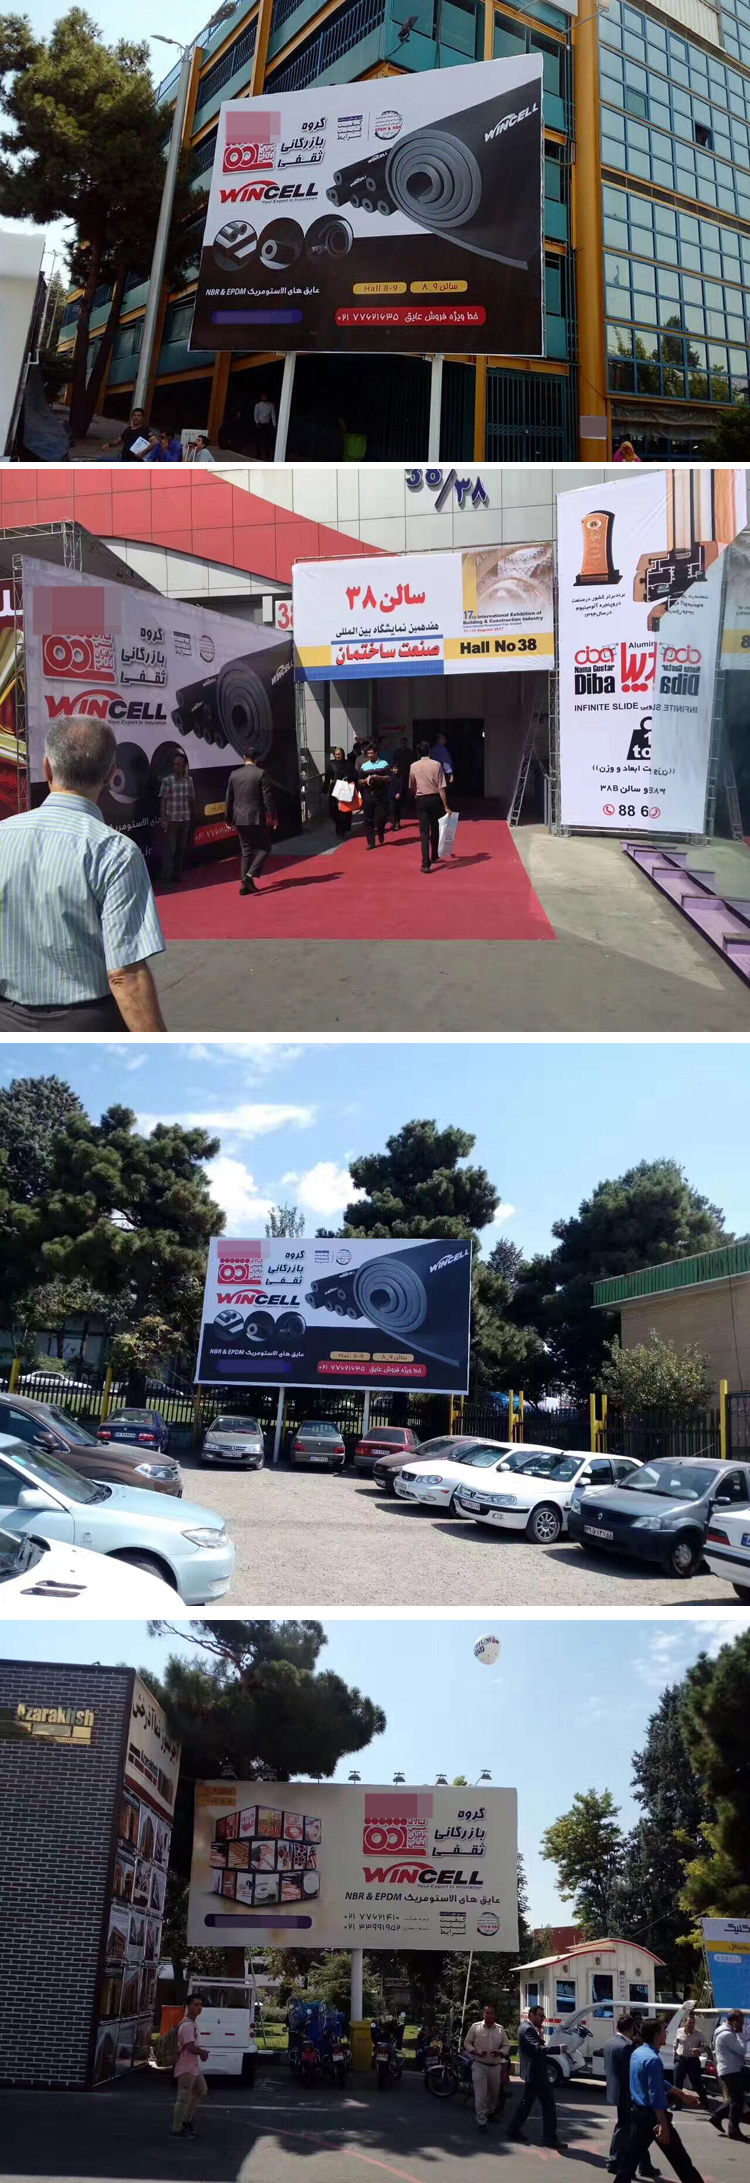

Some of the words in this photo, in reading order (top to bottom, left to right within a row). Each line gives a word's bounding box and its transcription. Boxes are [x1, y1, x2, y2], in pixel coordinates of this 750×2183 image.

[301, 117, 326, 131] گروه
[484, 102, 539, 143] WINCELL
[280, 136, 324, 152] بازرگانی
[277, 150, 323, 168] ثقفی
[219, 180, 319, 204] WINCELL
[205, 288, 220, 296] NBR
[220, 288, 226, 296] &
[226, 287, 247, 296] EPDM
[404, 312, 422, 322] عایق
[424, 311, 447, 322] فروش
[467, 311, 479, 320] خط
[345, 585, 377, 610] ۳۸
[379, 583, 426, 614] سالن
[277, 602, 294, 630] 3
[373, 622, 407, 636] نمایشگاه
[408, 621, 439, 634] هفدهمین
[140, 627, 163, 643] گروه
[398, 639, 440, 658] صنعت
[460, 640, 490, 655] Hall
[495, 640, 516, 653] No
[517, 638, 537, 652] 38
[121, 647, 165, 667] بازرگانی
[335, 642, 396, 666] ساختمان
[574, 665, 592, 673] Nama
[592, 664, 615, 672] Gostar
[120, 669, 166, 685] ثقفی
[574, 674, 615, 695] Diba
[44, 689, 167, 719] WINCELL
[574, 703, 610, 712] INFINITE
[612, 702, 639, 710] SLIDE
[620, 785, 641, 794] سالن
[618, 804, 636, 817] 88
[285, 1250, 305, 1259] گروه
[429, 1249, 469, 1273] WINCELL
[267, 1264, 304, 1274] بازرگانی
[265, 1275, 303, 1286] ثقفی
[216, 1289, 300, 1306] WINCELL
[16, 1703, 94, 1727] Azarakhsh
[457, 1807, 486, 1820] گروه
[434, 1826, 486, 1840] بازرگانی
[432, 1843, 486, 1857] ثقفی
[362, 1861, 484, 1885] WINCELL
[345, 1892, 364, 1900] NBR
[365, 1892, 374, 1900] &
[375, 1892, 402, 1901] EPDM
[403, 1893, 457, 1904] الاستومریک
[458, 1895, 478, 1904] های
[479, 1895, 500, 1905] عایق
